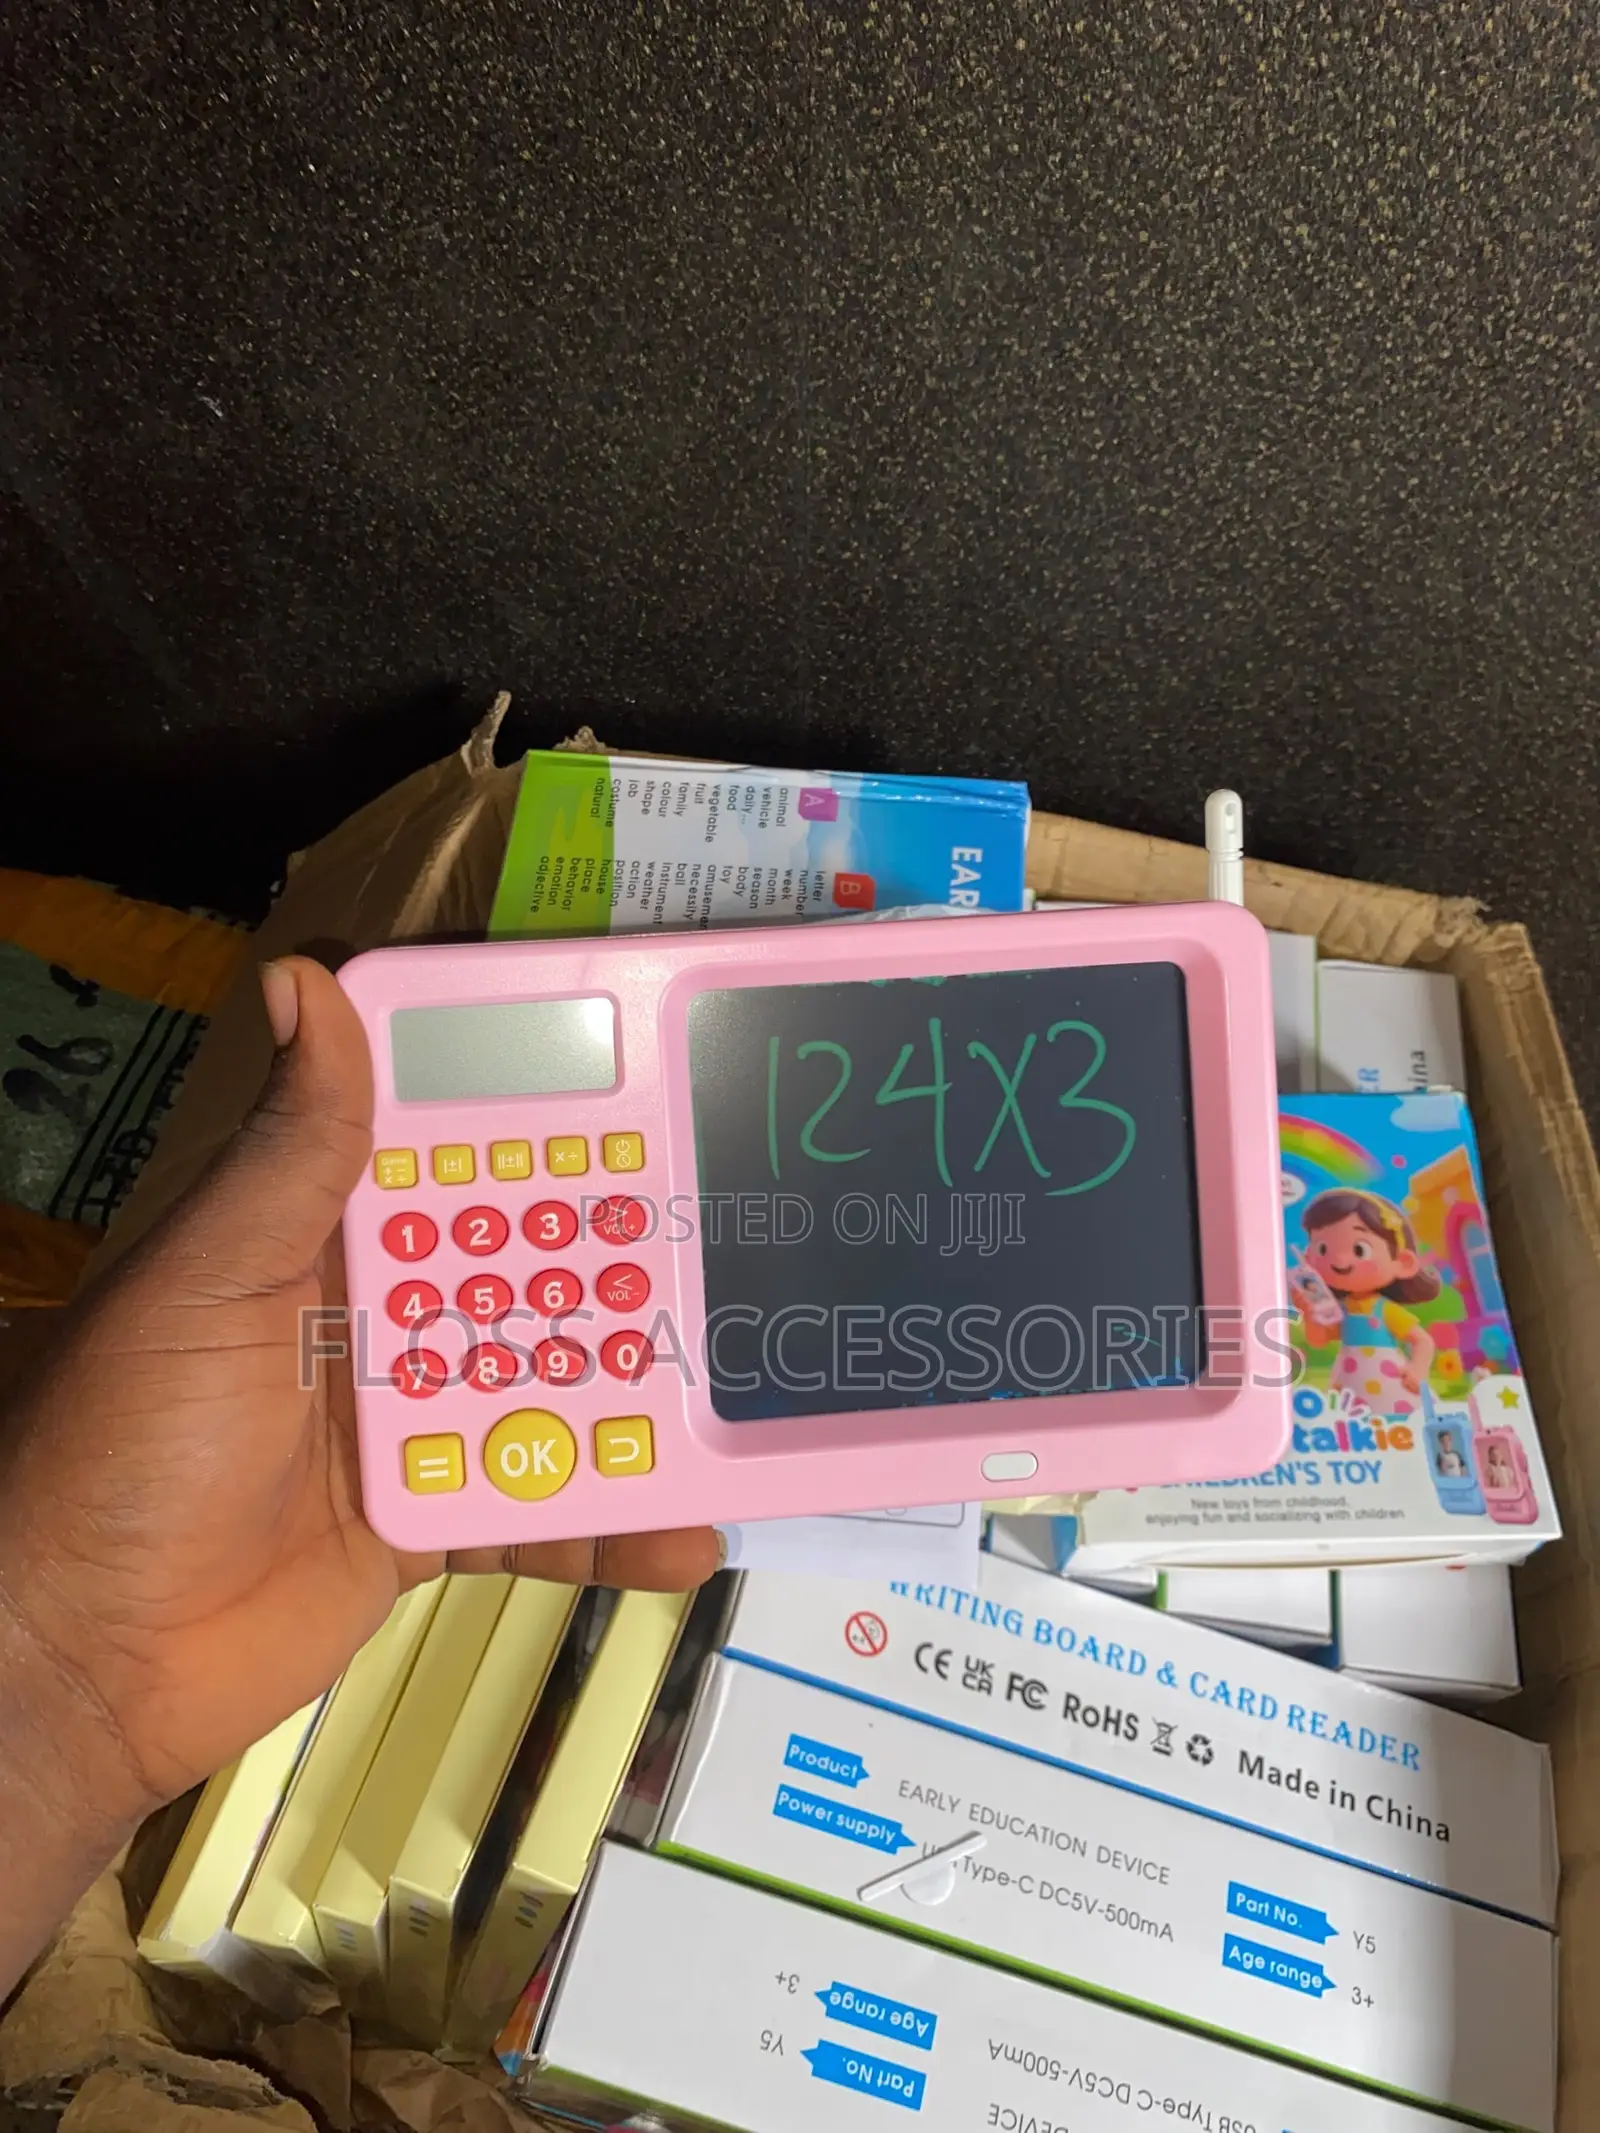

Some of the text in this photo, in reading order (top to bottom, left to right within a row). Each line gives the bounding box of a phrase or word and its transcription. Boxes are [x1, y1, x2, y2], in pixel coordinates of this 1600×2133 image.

[590, 777, 606, 818] natural
[605, 778, 622, 828] costume
[628, 778, 640, 798] job
[641, 779, 655, 816] shape
[658, 781, 672, 818] colour
[674, 781, 690, 817] family
[694, 782, 706, 805] fruit
[727, 784, 740, 811] food
[758, 786, 772, 829] vehicle
[776, 787, 789, 828] animal
[705, 783, 721, 843] vegetable
[530, 855, 550, 914] adjective
[547, 856, 566, 906] emotion
[562, 857, 582, 912] behavior
[581, 857, 595, 894] place
[595, 858, 612, 895] house
[609, 859, 626, 907] position
[626, 860, 641, 899] action
[639, 861, 656, 911] weather
[652, 861, 674, 925] instrument
[683, 863, 701, 921] necessity
[719, 865, 734, 885] toy
[733, 865, 749, 898] body
[749, 867, 763, 910] season
[765, 867, 779, 907] month
[781, 868, 794, 901] week
[795, 869, 809, 917] number
[812, 870, 826, 903] letter
[700, 864, 717, 931] amusemen
[401, 1224, 415, 1254] 1
[468, 1217, 492, 1248] 2
[539, 1212, 562, 1242] 3
[403, 1292, 424, 1320] 4
[473, 1287, 496, 1316] 5
[543, 1280, 565, 1309] 6
[406, 1343, 639, 1392] 7 8 9 0
[499, 1438, 561, 1479] OK
[1326, 1459, 1383, 1485] TOY
[1202, 1510, 1225, 1524] fun
[1227, 1510, 1251, 1523] and
[1324, 1507, 1350, 1521] with
[1252, 1496, 1282, 1509] from
[914, 1641, 954, 1681] CE
[1032, 1617, 1148, 1677] BOARD
[1155, 1660, 1179, 1690] &
[1188, 1670, 1279, 1721] CARD
[1286, 1702, 1422, 1772] READER
[1062, 1691, 1140, 1743] RoHS
[788, 1743, 859, 1779] Product
[1237, 1749, 1451, 1843] Made in China
[777, 1790, 897, 1845] Power supply
[898, 1779, 962, 1814] EARLY
[968, 1803, 1088, 1858] EDUCATION
[1096, 1845, 1172, 1886] DEVICE
[963, 1855, 1175, 1942] Type-C DC5V-500mA
[1235, 1891, 1303, 1929] Part No.
[1352, 1930, 1377, 1955] Y5
[774, 1970, 801, 1995] 3+
[1228, 1945, 1323, 1989] Age range
[829, 1991, 930, 2039] Age range
[1351, 1985, 1375, 2009] 3+
[759, 2028, 785, 2056] Y5
[842, 2056, 915, 2099] Part No.
[987, 2037, 1132, 2105] DC5V-500mA
[1136, 2088, 1213, 2133] Type-C
